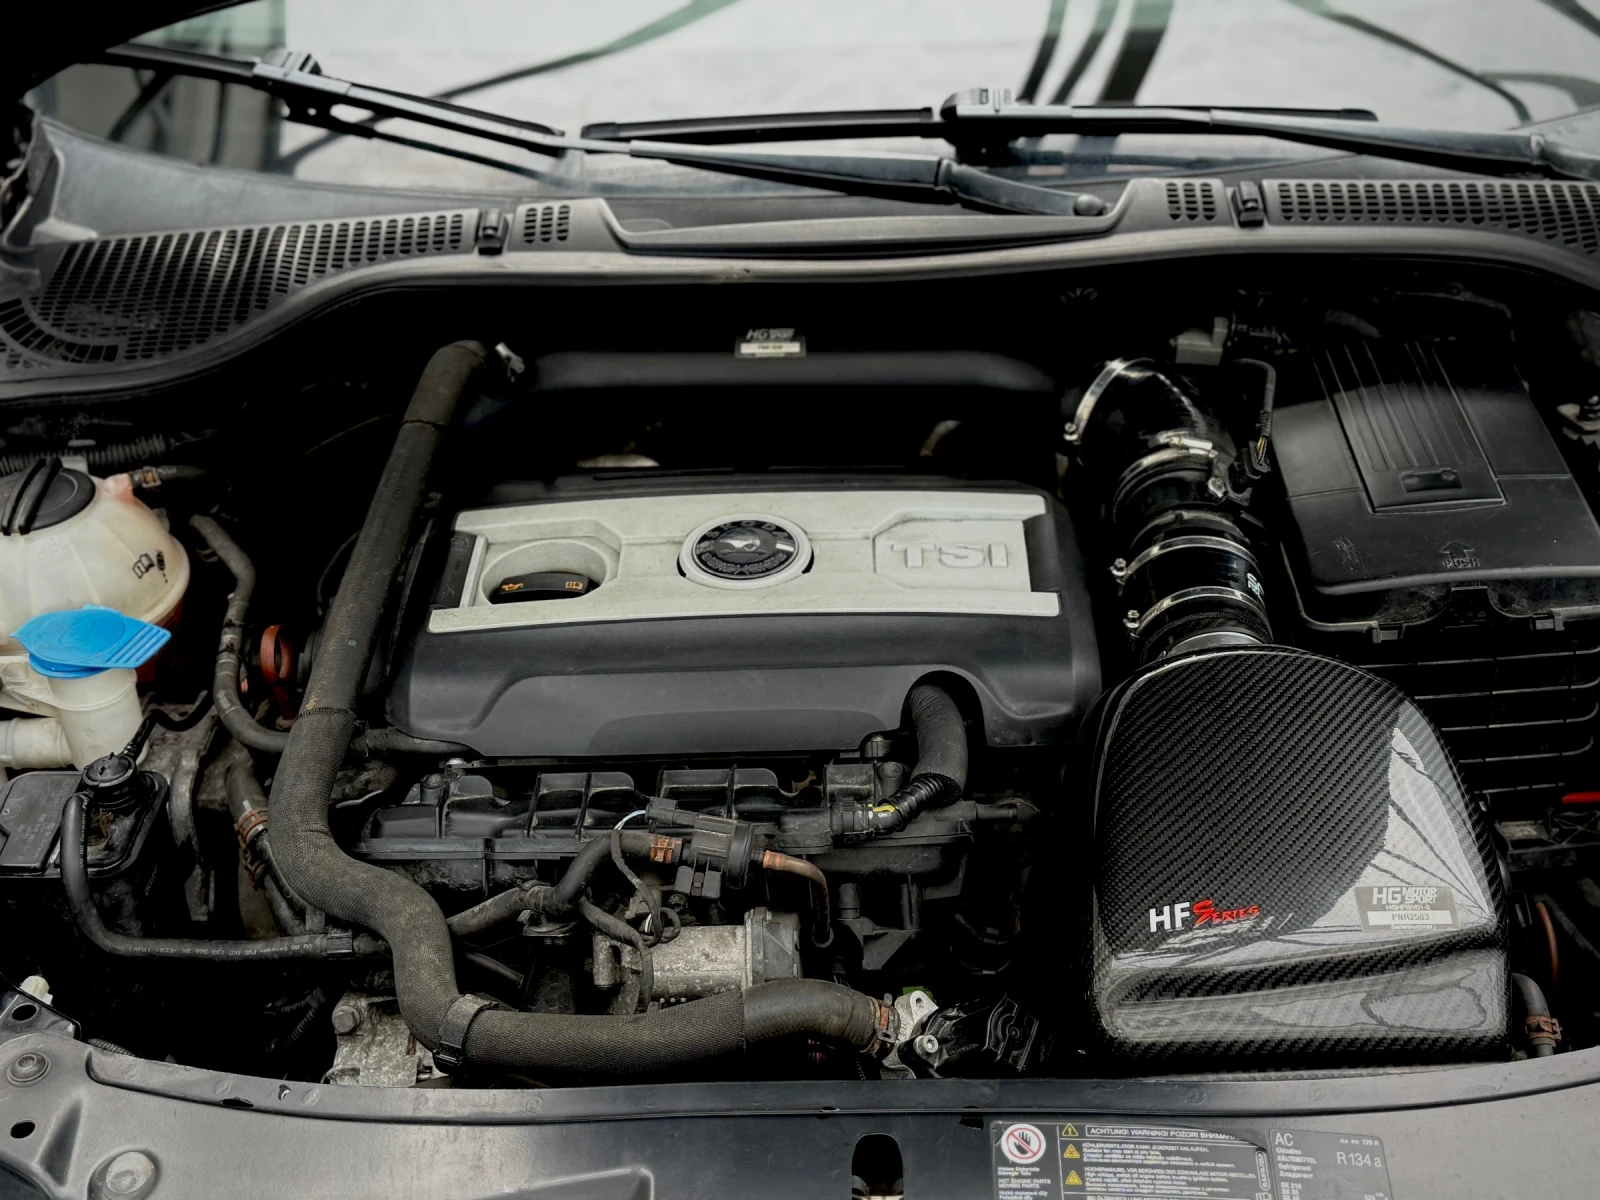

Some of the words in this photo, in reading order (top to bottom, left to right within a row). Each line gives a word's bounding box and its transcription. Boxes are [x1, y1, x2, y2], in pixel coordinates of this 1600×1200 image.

[891, 543, 1009, 568] TSI
[1442, 558, 1480, 570] PUSH
[1372, 887, 1402, 904] HG
[1402, 886, 1438, 897] MOTOR
[1404, 895, 1436, 904] SPORT
[1149, 902, 1190, 932] HF
[1090, 1127, 1129, 1136] ACHTUNG!
[1130, 1129, 1168, 1137] WARNING!
[1275, 1132, 1294, 1146] AC
